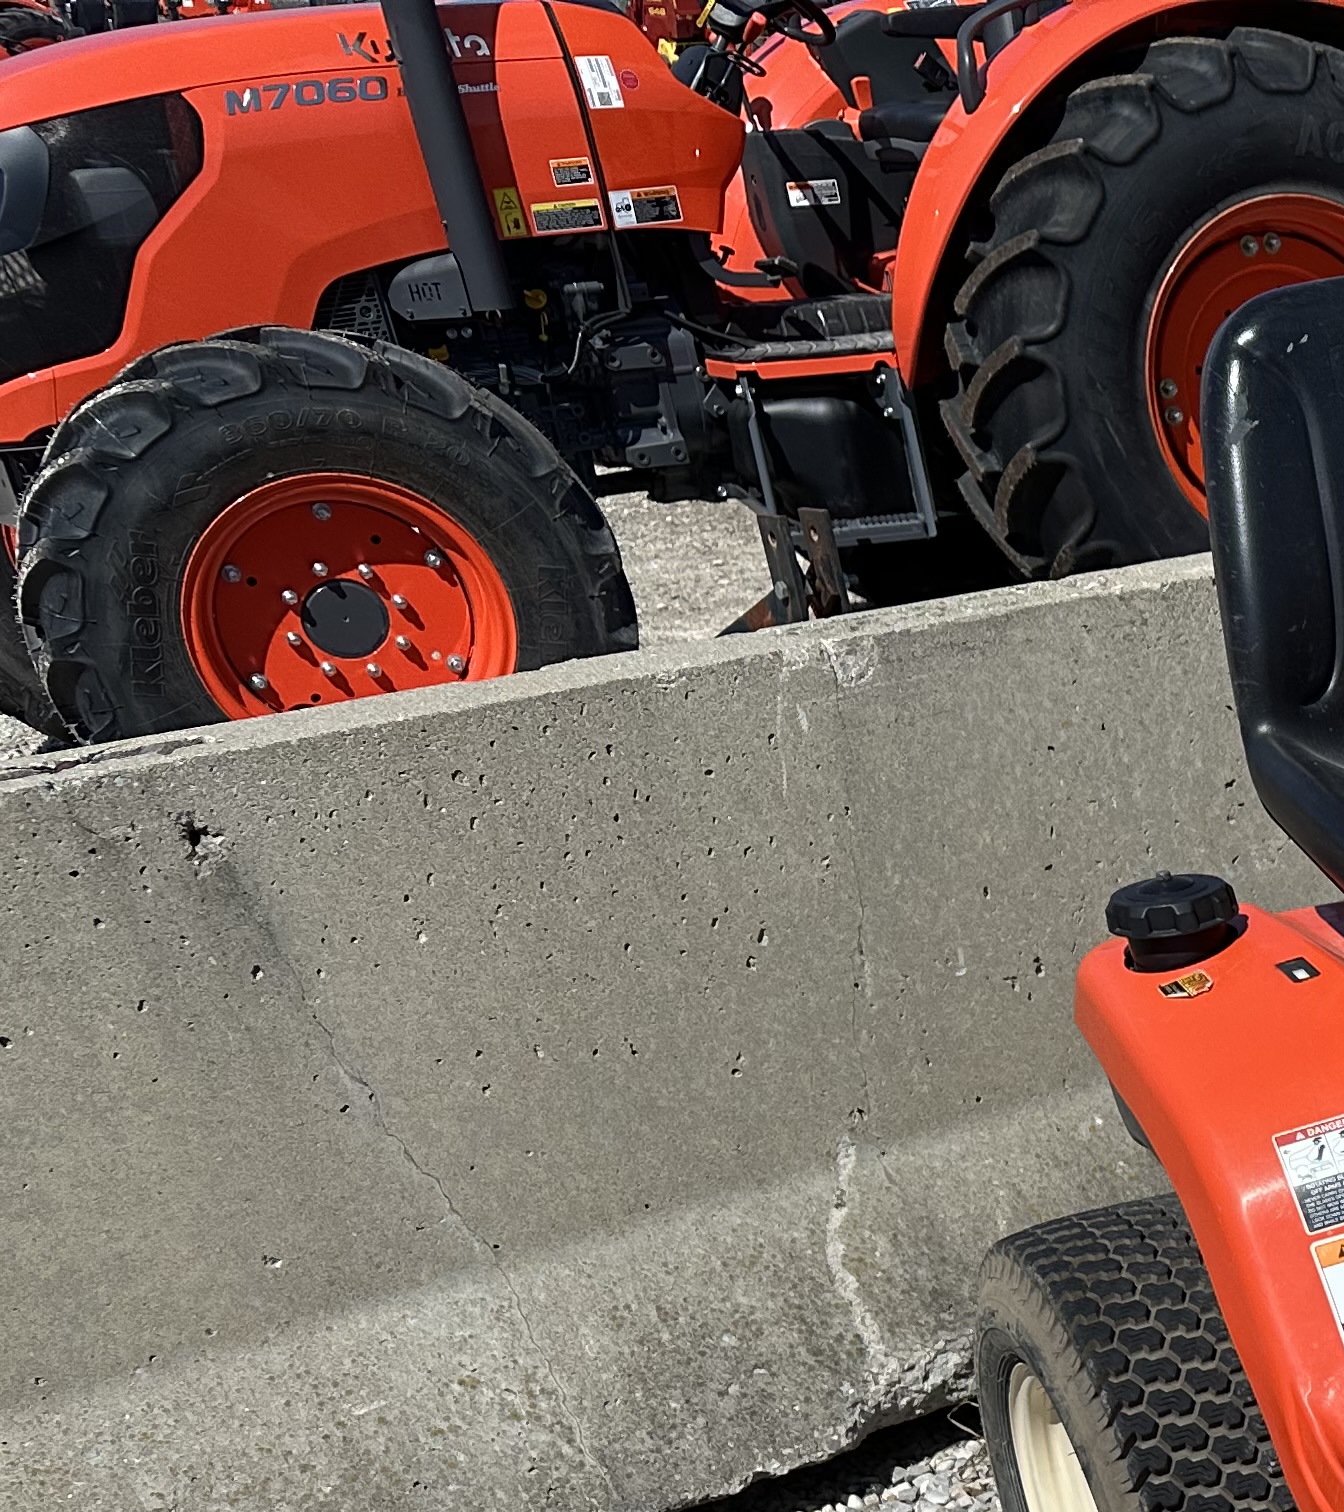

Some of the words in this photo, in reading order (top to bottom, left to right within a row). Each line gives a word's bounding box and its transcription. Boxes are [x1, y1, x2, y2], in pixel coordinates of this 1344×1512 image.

[337, 27, 490, 63] Kuta
[224, 76, 388, 116] M7060
[408, 282, 442, 302] HOT
[127, 530, 166, 698] Kleber
